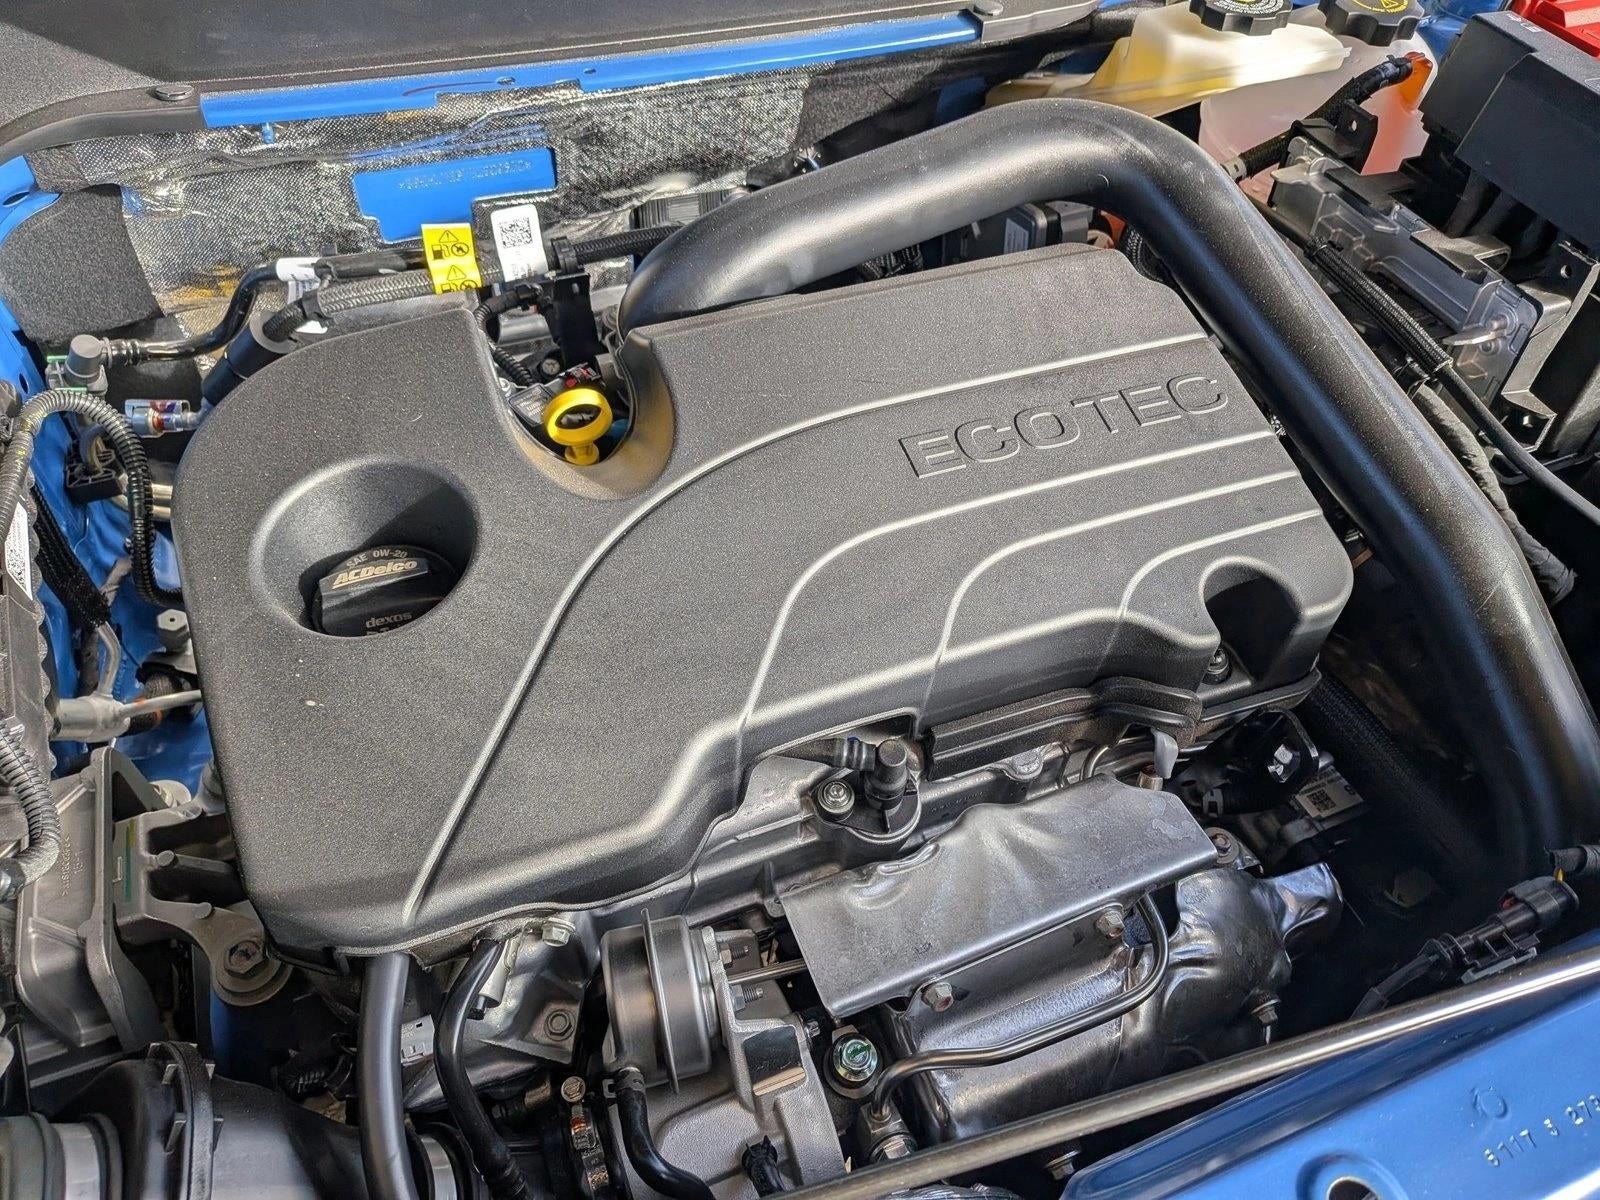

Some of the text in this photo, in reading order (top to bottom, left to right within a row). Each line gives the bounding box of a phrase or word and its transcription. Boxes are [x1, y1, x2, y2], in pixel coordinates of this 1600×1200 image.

[898, 373, 1228, 478] ECOTEC
[346, 549, 408, 568] SAE 0W-20
[332, 560, 418, 586] ACDelco
[365, 612, 412, 628] dexos
